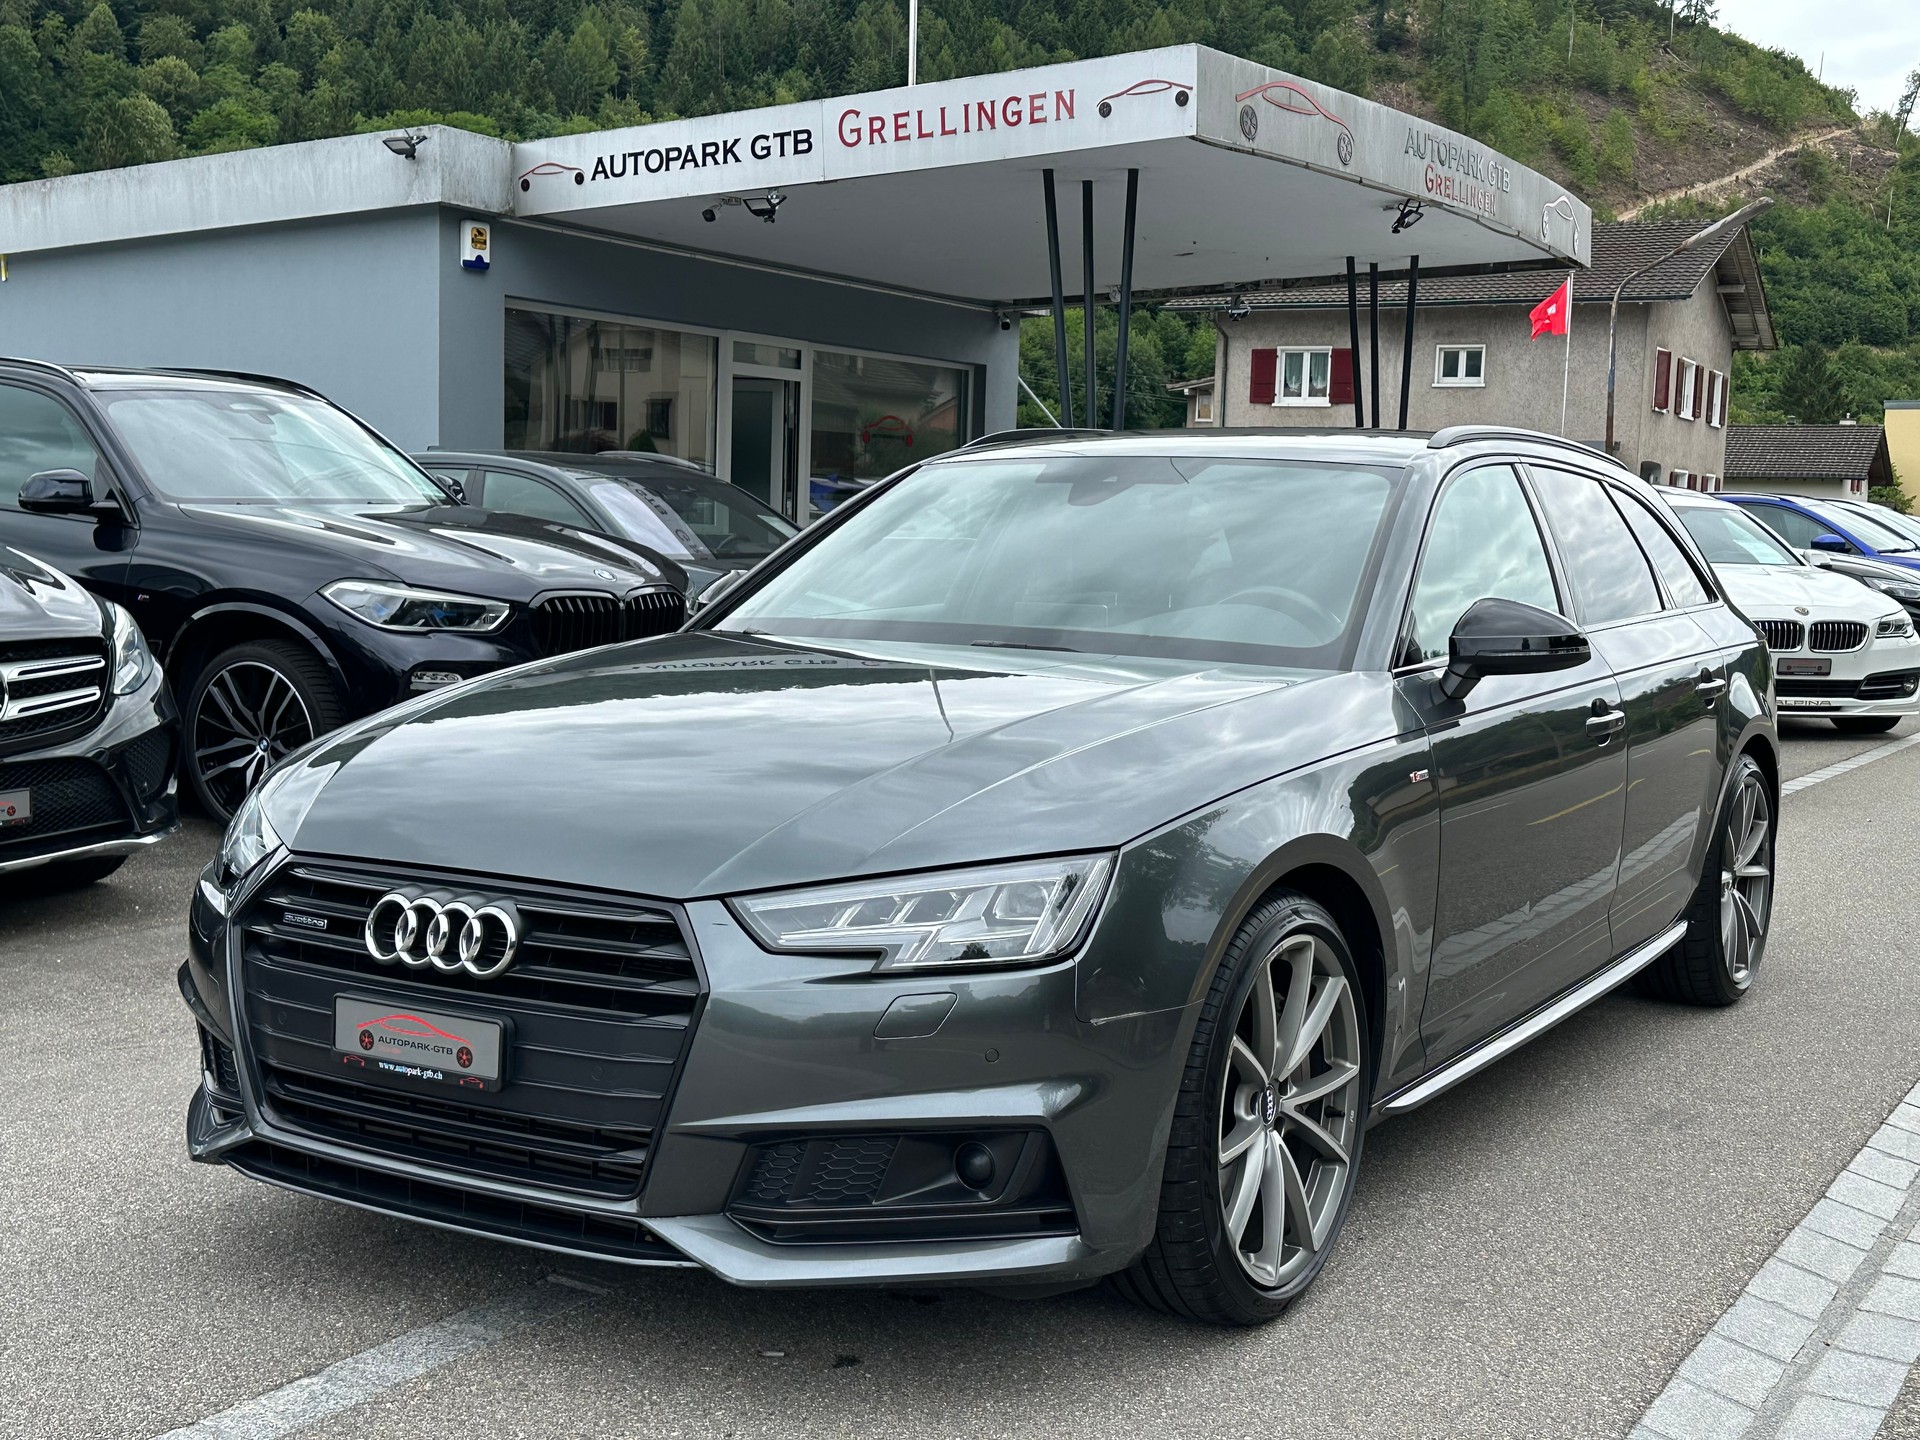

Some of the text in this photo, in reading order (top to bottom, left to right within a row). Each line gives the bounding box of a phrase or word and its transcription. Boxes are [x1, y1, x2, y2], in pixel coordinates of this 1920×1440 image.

[591, 137, 742, 181] AUTOPARK
[750, 128, 813, 160] GTB
[1404, 127, 1510, 193] AUTOPARK GTB
[378, 1035, 454, 1055] AUTOPARK-GTB
[378, 1061, 443, 1081] www.autopark-gtb.ch
